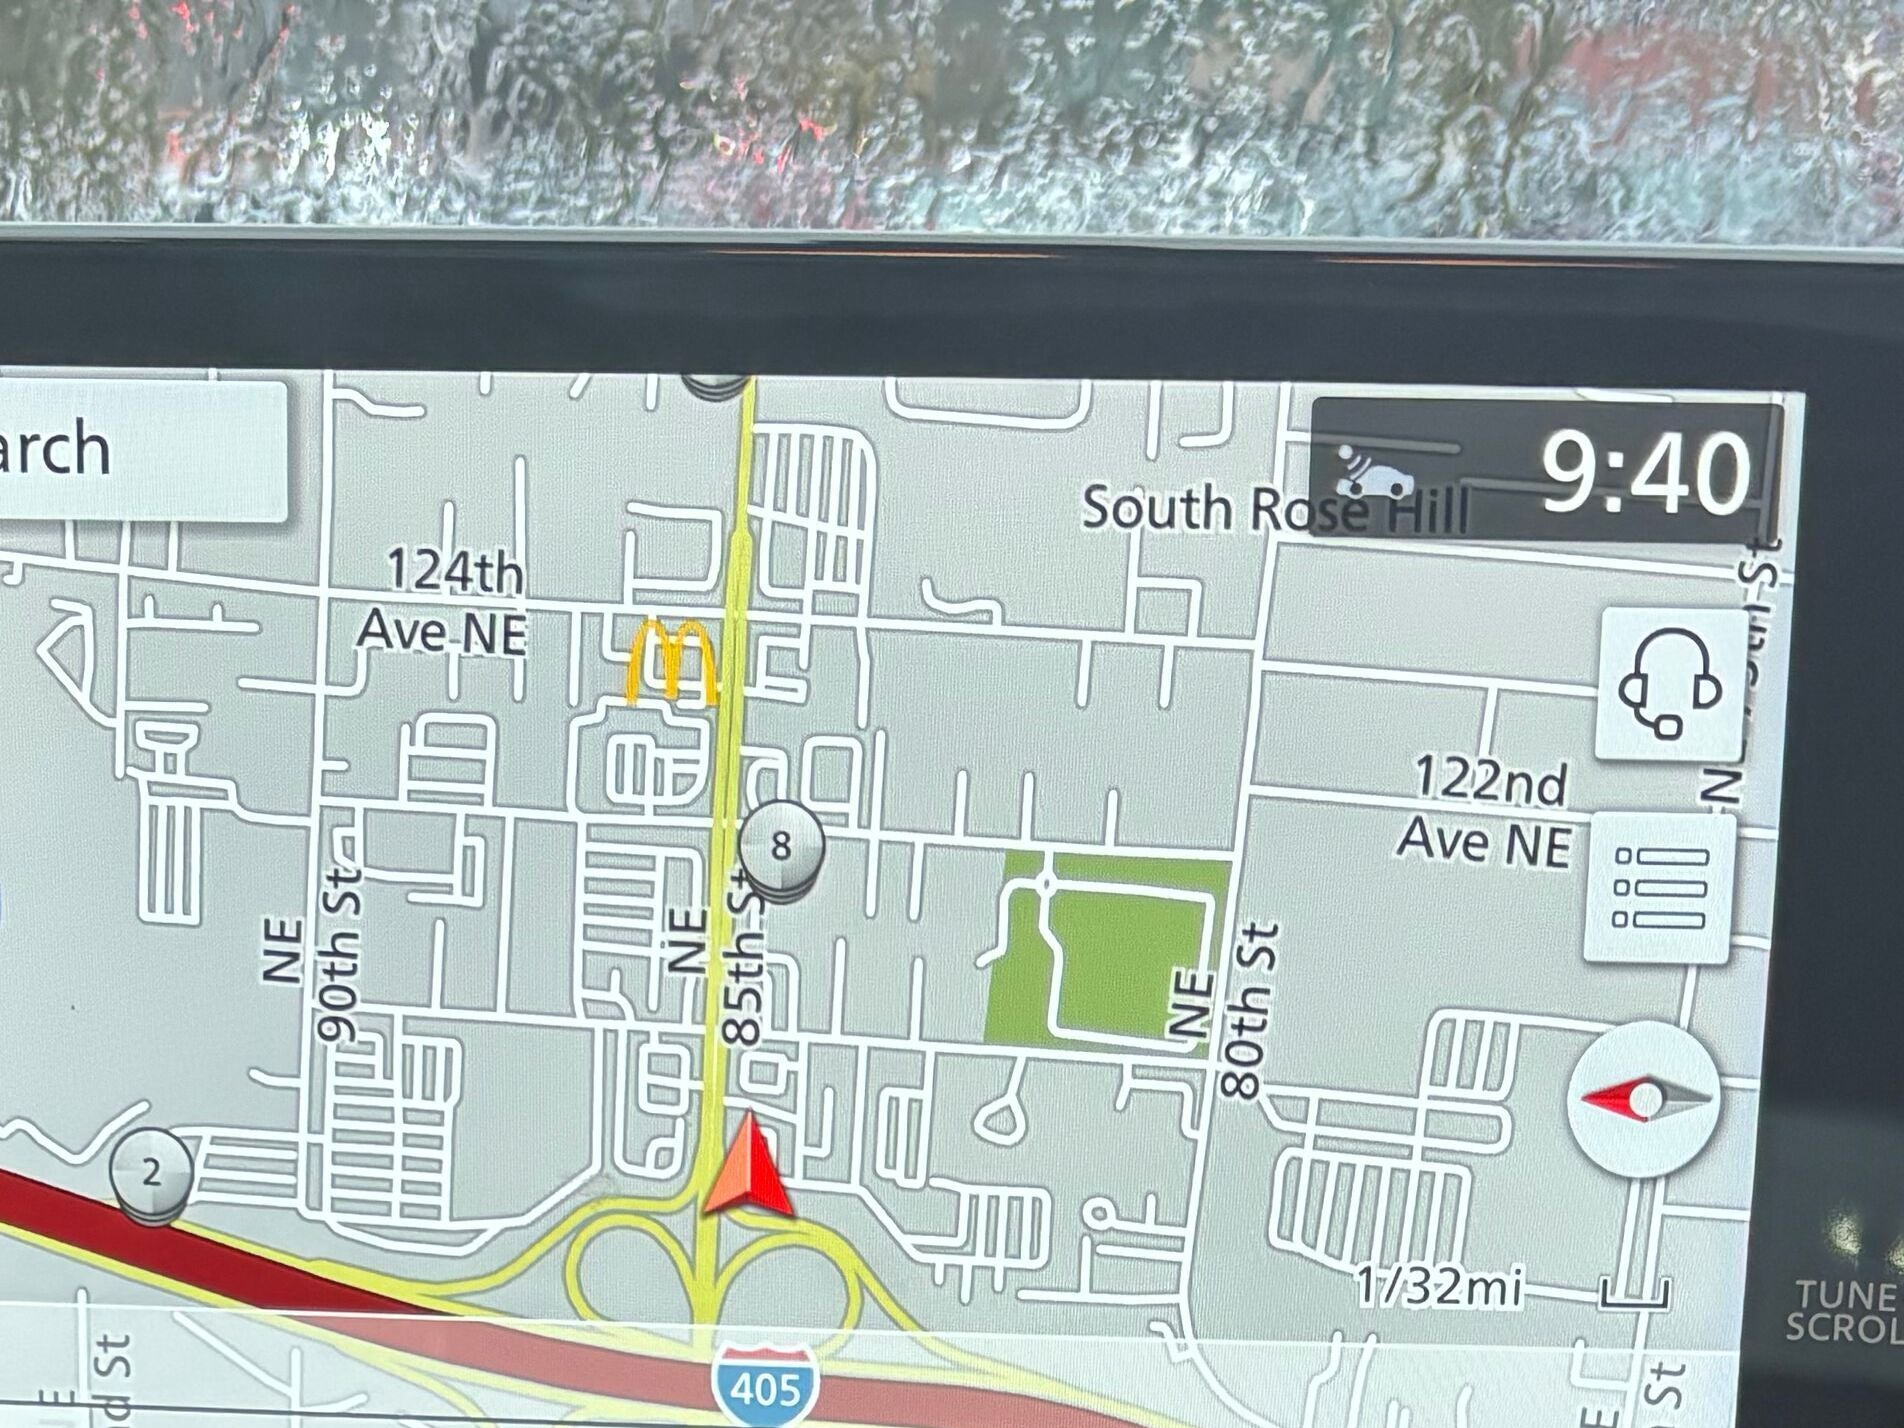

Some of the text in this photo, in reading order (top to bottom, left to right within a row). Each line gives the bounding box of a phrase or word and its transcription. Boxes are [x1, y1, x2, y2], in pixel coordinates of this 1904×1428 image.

[1542, 428, 1752, 515] 9:40
[1083, 482, 1469, 534] South Rose Hill
[387, 549, 524, 593] 124th
[357, 608, 527, 655] Ave NE
[1415, 754, 1568, 807] 122nd
[1700, 767, 1744, 804] N
[770, 831, 792, 860] 8
[1396, 815, 1572, 868] Ave NE
[262, 917, 302, 984] NE
[317, 867, 363, 1042] 90th St
[668, 907, 708, 975] NE
[721, 932, 765, 1047] 85th
[1169, 968, 1215, 1039] NE
[1220, 921, 1280, 1101] 80th St
[142, 1157, 162, 1188] 2
[1357, 1266, 1524, 1308] 1/32mi
[93, 1334, 131, 1378] St
[729, 1372, 802, 1408] 405
[1643, 1361, 1686, 1410] St
